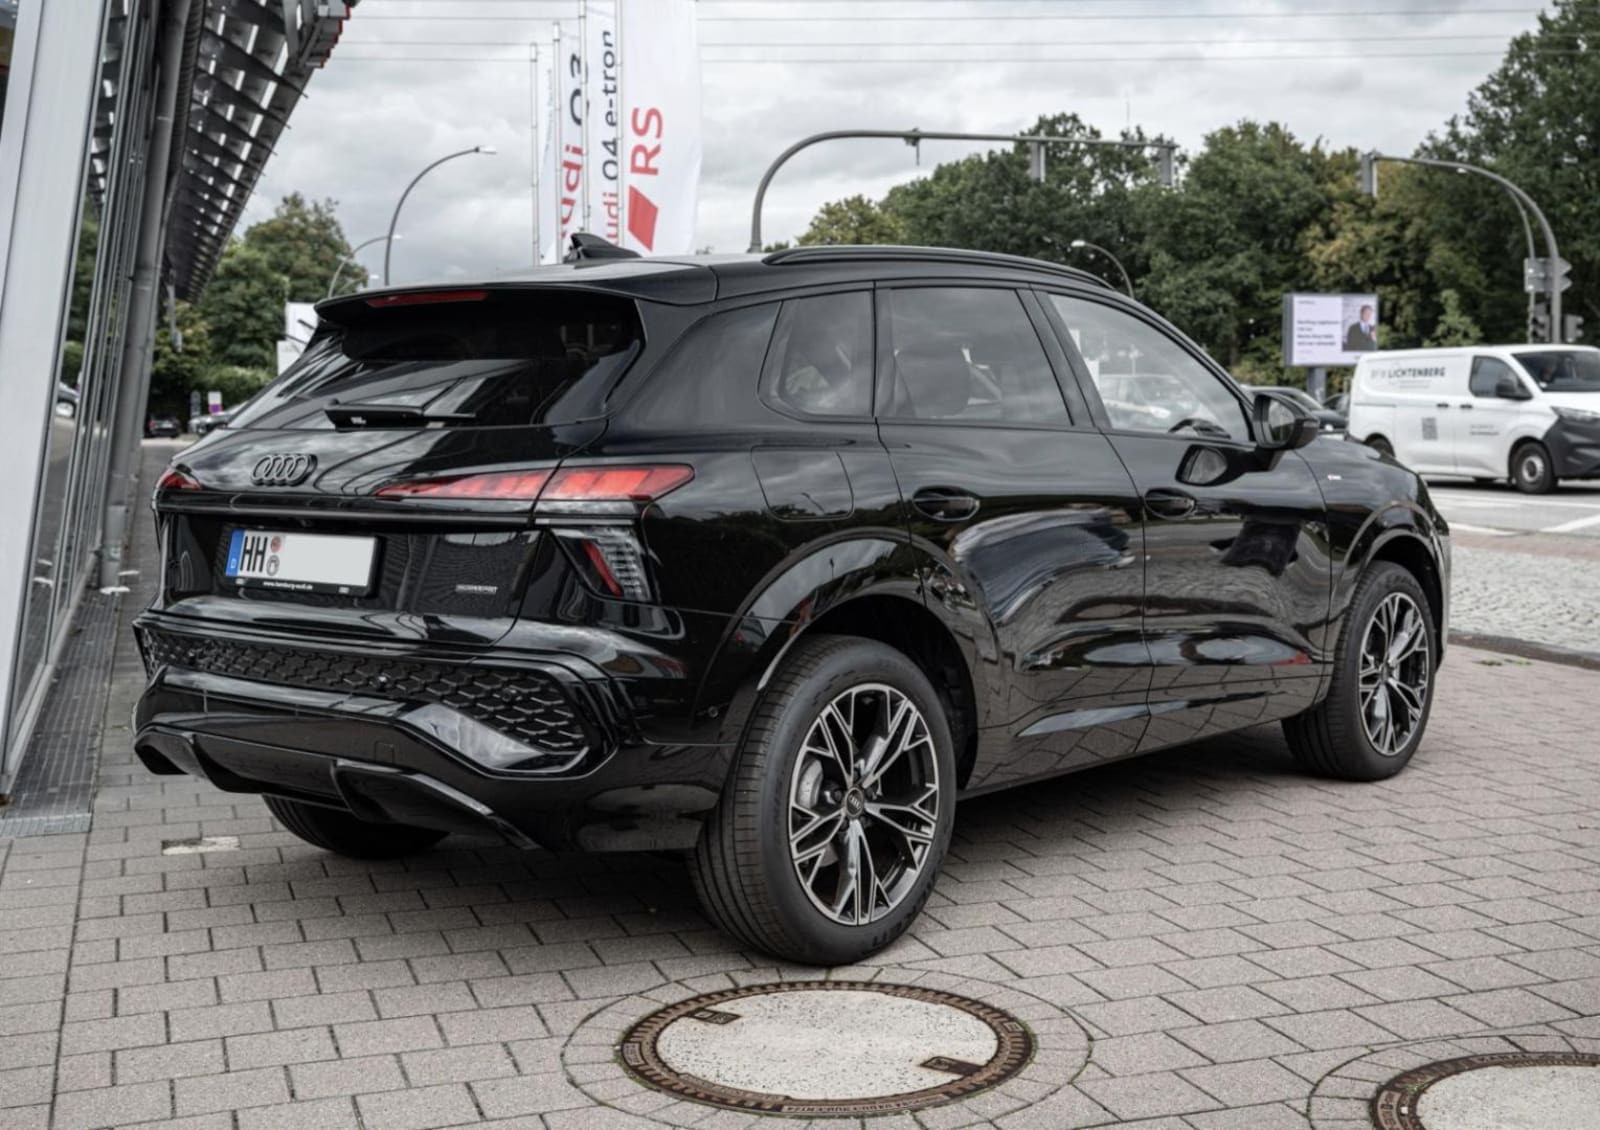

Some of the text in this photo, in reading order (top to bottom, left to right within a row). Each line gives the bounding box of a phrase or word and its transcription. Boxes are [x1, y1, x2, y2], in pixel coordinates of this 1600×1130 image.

[602, 31, 617, 127] e-tron
[630, 107, 663, 176] RS
[561, 145, 584, 238] udi
[603, 192, 618, 246] udi
[240, 536, 268, 573] HH
